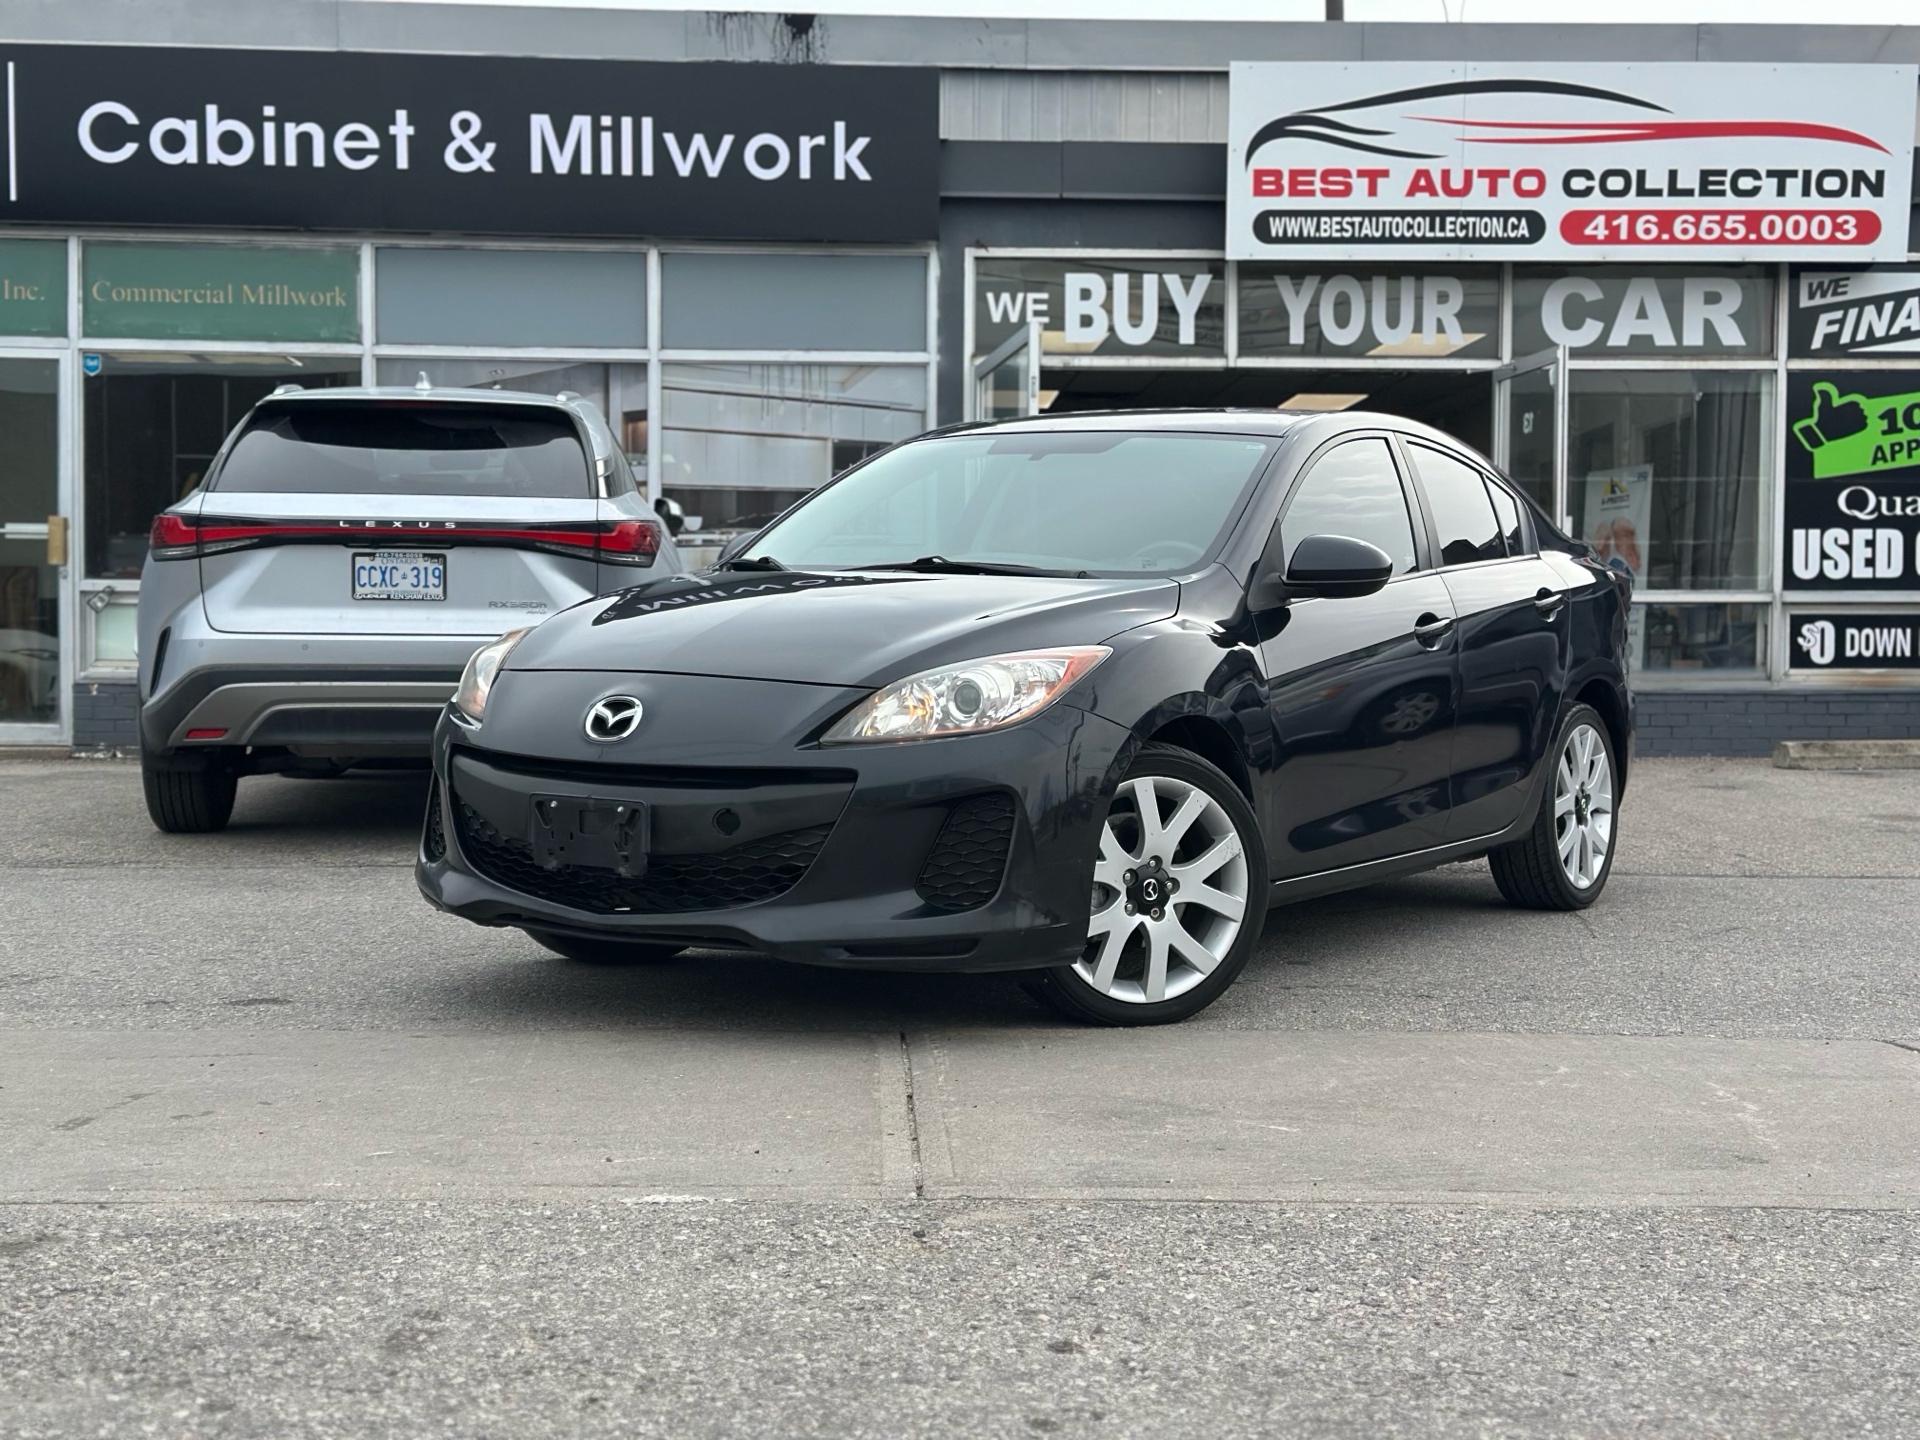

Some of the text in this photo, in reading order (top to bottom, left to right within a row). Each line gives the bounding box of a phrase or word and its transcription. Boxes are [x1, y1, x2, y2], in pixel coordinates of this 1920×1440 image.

[77, 101, 873, 181] Cabinet & Millwork
[1252, 168, 1886, 199] BEST AUTO COLLECTION
[1269, 216, 1530, 239] WWW.BESTAUTOCOLLECTION.CA
[1583, 214, 1858, 241] 416.655.0003
[3, 279, 46, 301] Inc.
[92, 281, 347, 307] Commercial Millwork
[1807, 276, 1851, 301] WE
[986, 273, 1747, 348] WE BUY YOUR CAR
[339, 520, 456, 529] LEXUS
[1792, 528, 1905, 580] USED
[357, 565, 442, 588] CCXC 319
[1797, 620, 1836, 665] $0
[1845, 627, 1911, 658] DOWN
